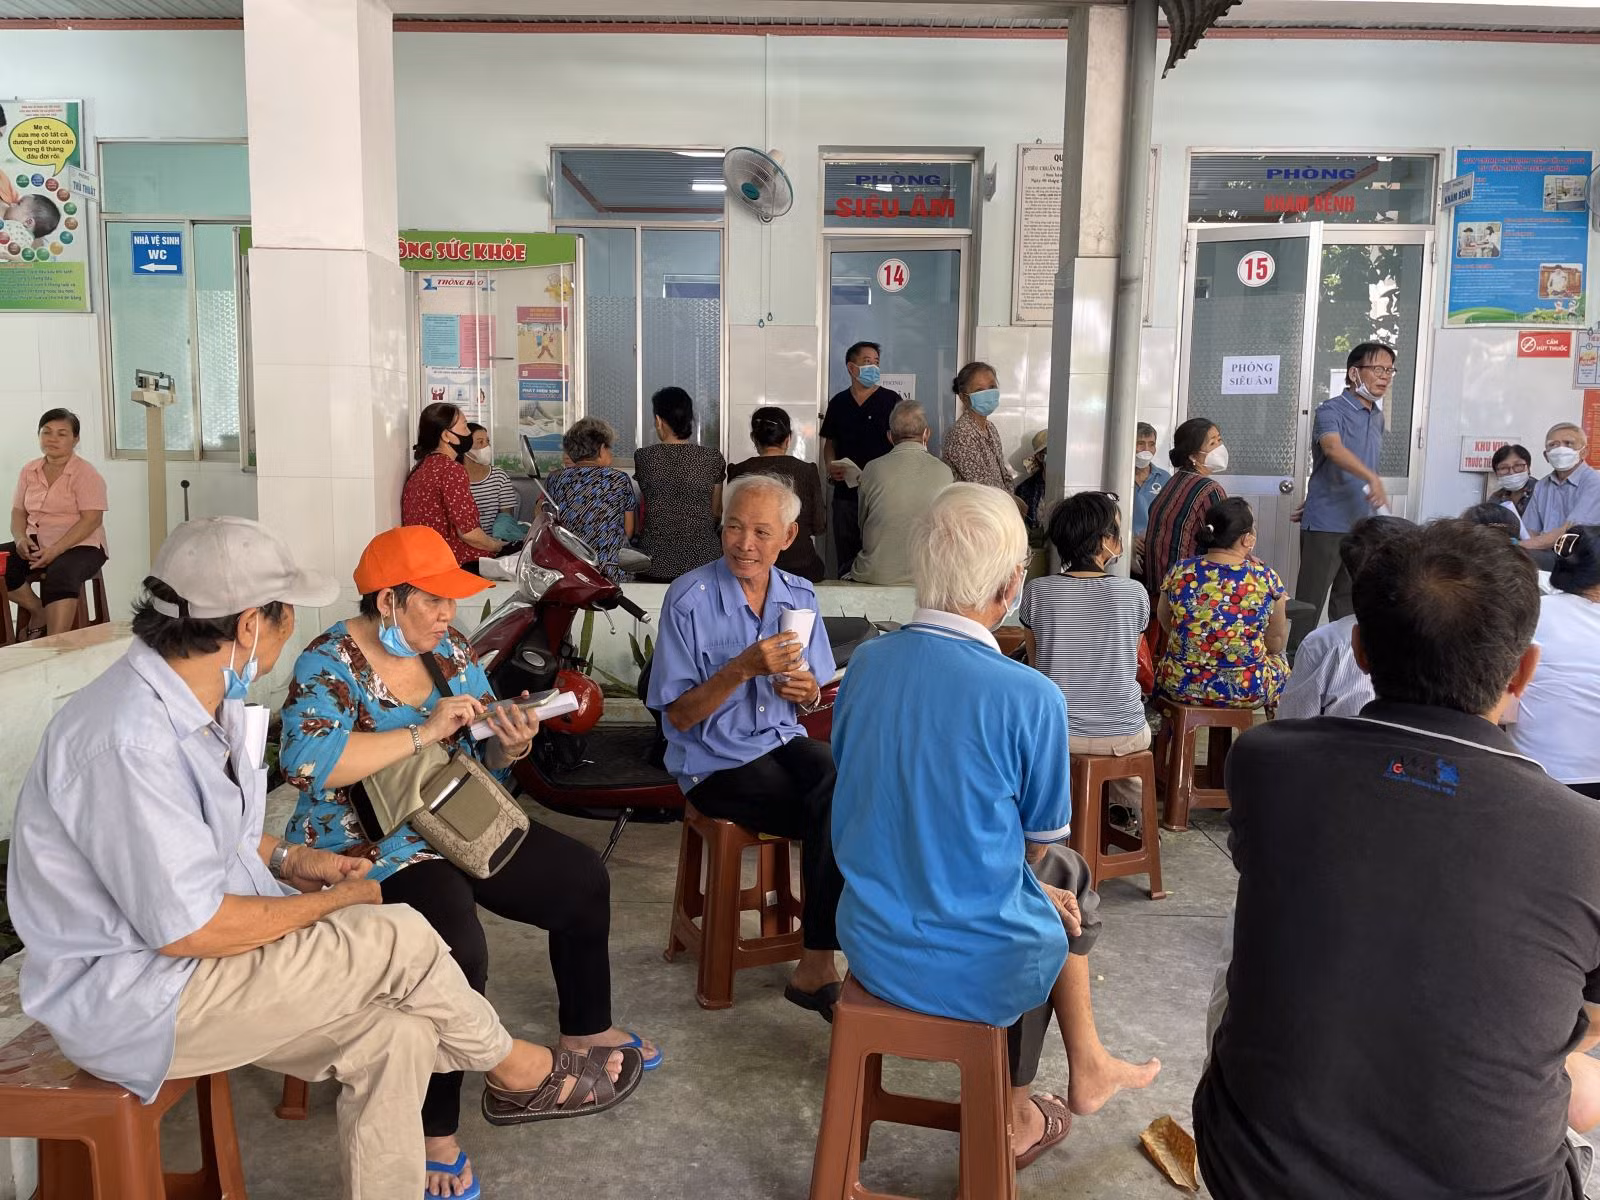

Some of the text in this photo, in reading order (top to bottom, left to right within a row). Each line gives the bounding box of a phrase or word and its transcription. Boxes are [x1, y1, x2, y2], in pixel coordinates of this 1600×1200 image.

[1054, 154, 1063, 162] QU
[855, 170, 941, 186] PHÒNG
[1266, 165, 1356, 180] PHÒNG
[835, 191, 956, 219] SIÊU ÂM
[1263, 191, 1356, 215] KHÁM BỆNH
[133, 234, 180, 247] NHÀ VỆ SINH
[147, 249, 168, 260] WC
[398, 237, 527, 262] ÔNG SỨC KHỎE
[884, 264, 905, 286] 14
[1245, 257, 1268, 281] 15
[436, 278, 465, 286] THÔNG
[1549, 344, 1568, 352] THUỐC
[1231, 361, 1273, 373] PHÒNG
[1229, 376, 1273, 386] SIÊU ÂM
[1474, 441, 1491, 452] KHU
[1465, 456, 1483, 468] TRƯỚC
